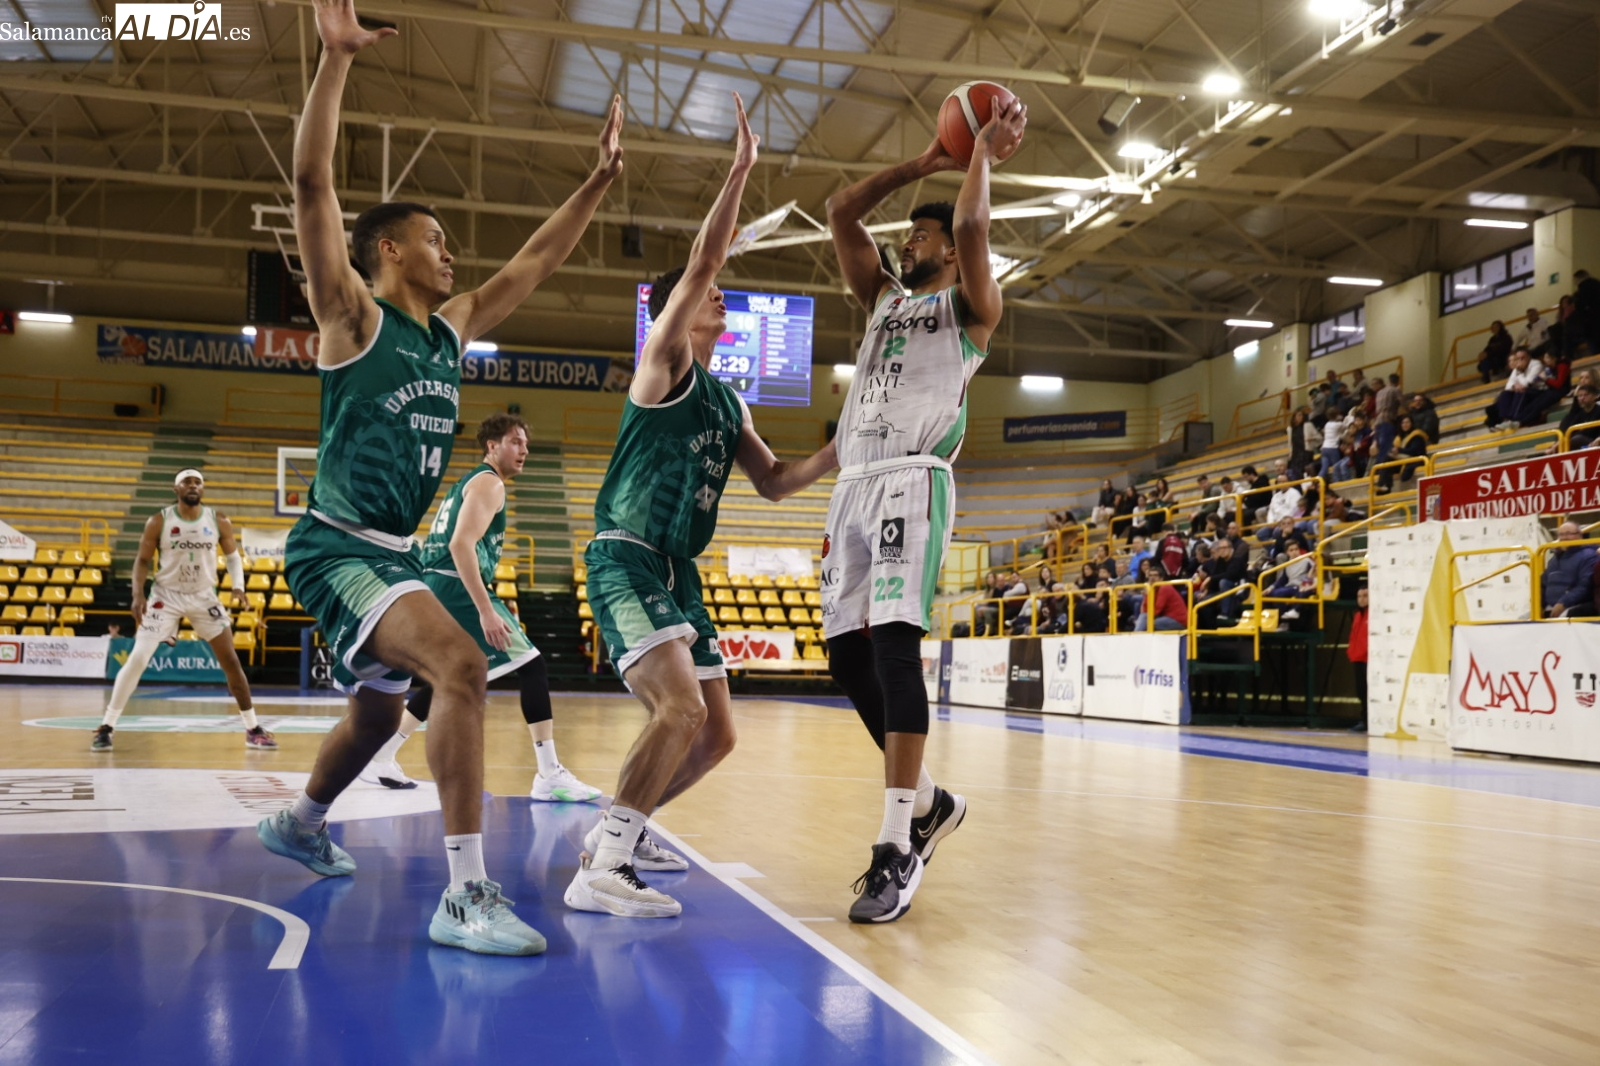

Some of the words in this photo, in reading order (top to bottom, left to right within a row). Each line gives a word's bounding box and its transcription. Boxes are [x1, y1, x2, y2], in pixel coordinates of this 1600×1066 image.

[484, 358, 512, 383] DE
[517, 362, 600, 386] EUROPA
[411, 413, 454, 434] OVIEDO
[420, 444, 442, 477] 14
[1450, 492, 1546, 519] PATRIMONIO
[1550, 489, 1575, 512] DE
[875, 577, 904, 602] 22
